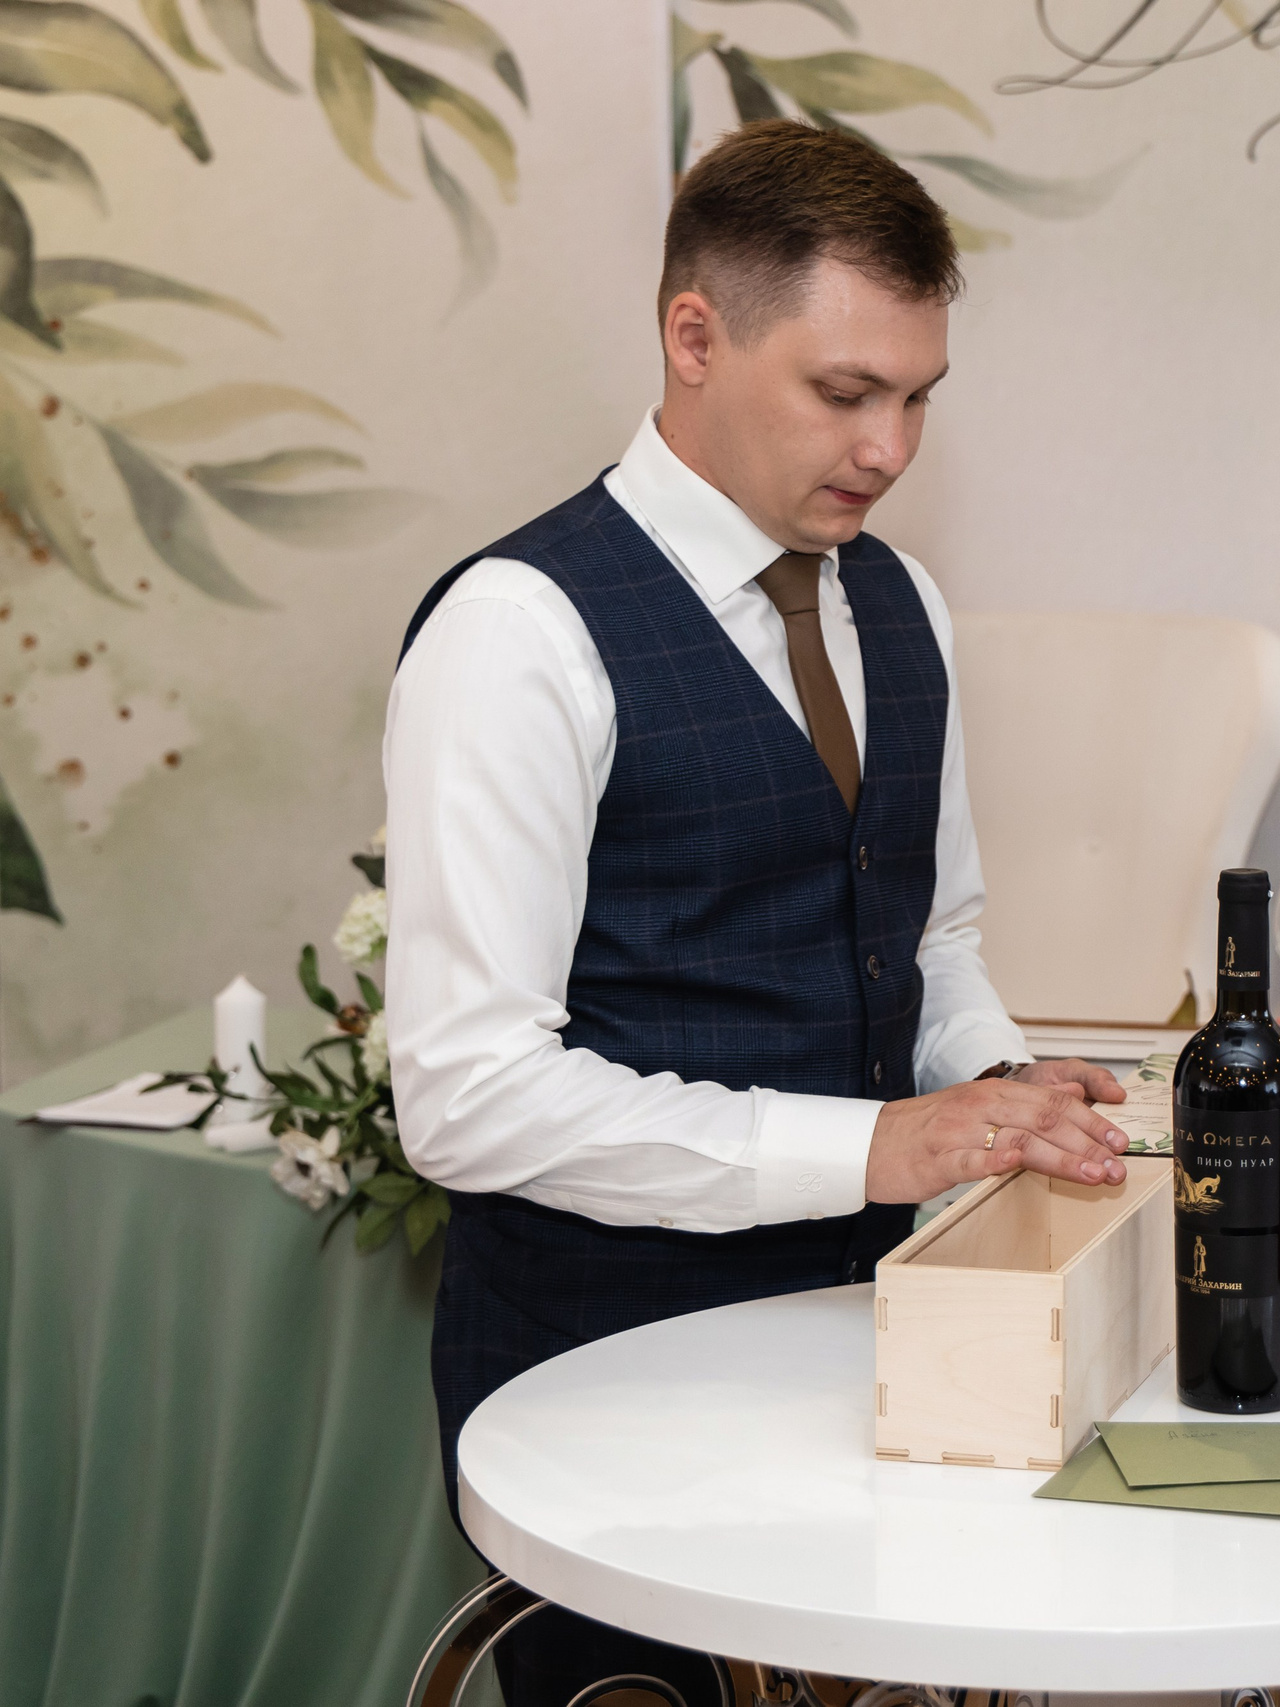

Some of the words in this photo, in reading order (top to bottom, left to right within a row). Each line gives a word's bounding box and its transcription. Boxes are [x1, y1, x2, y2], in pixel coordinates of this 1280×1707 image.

[1197, 1156, 1233, 1168] ПИНО
[1240, 1157, 1275, 1168] НУАР
[1198, 1279, 1242, 1290] ЗАХАРЬИН
